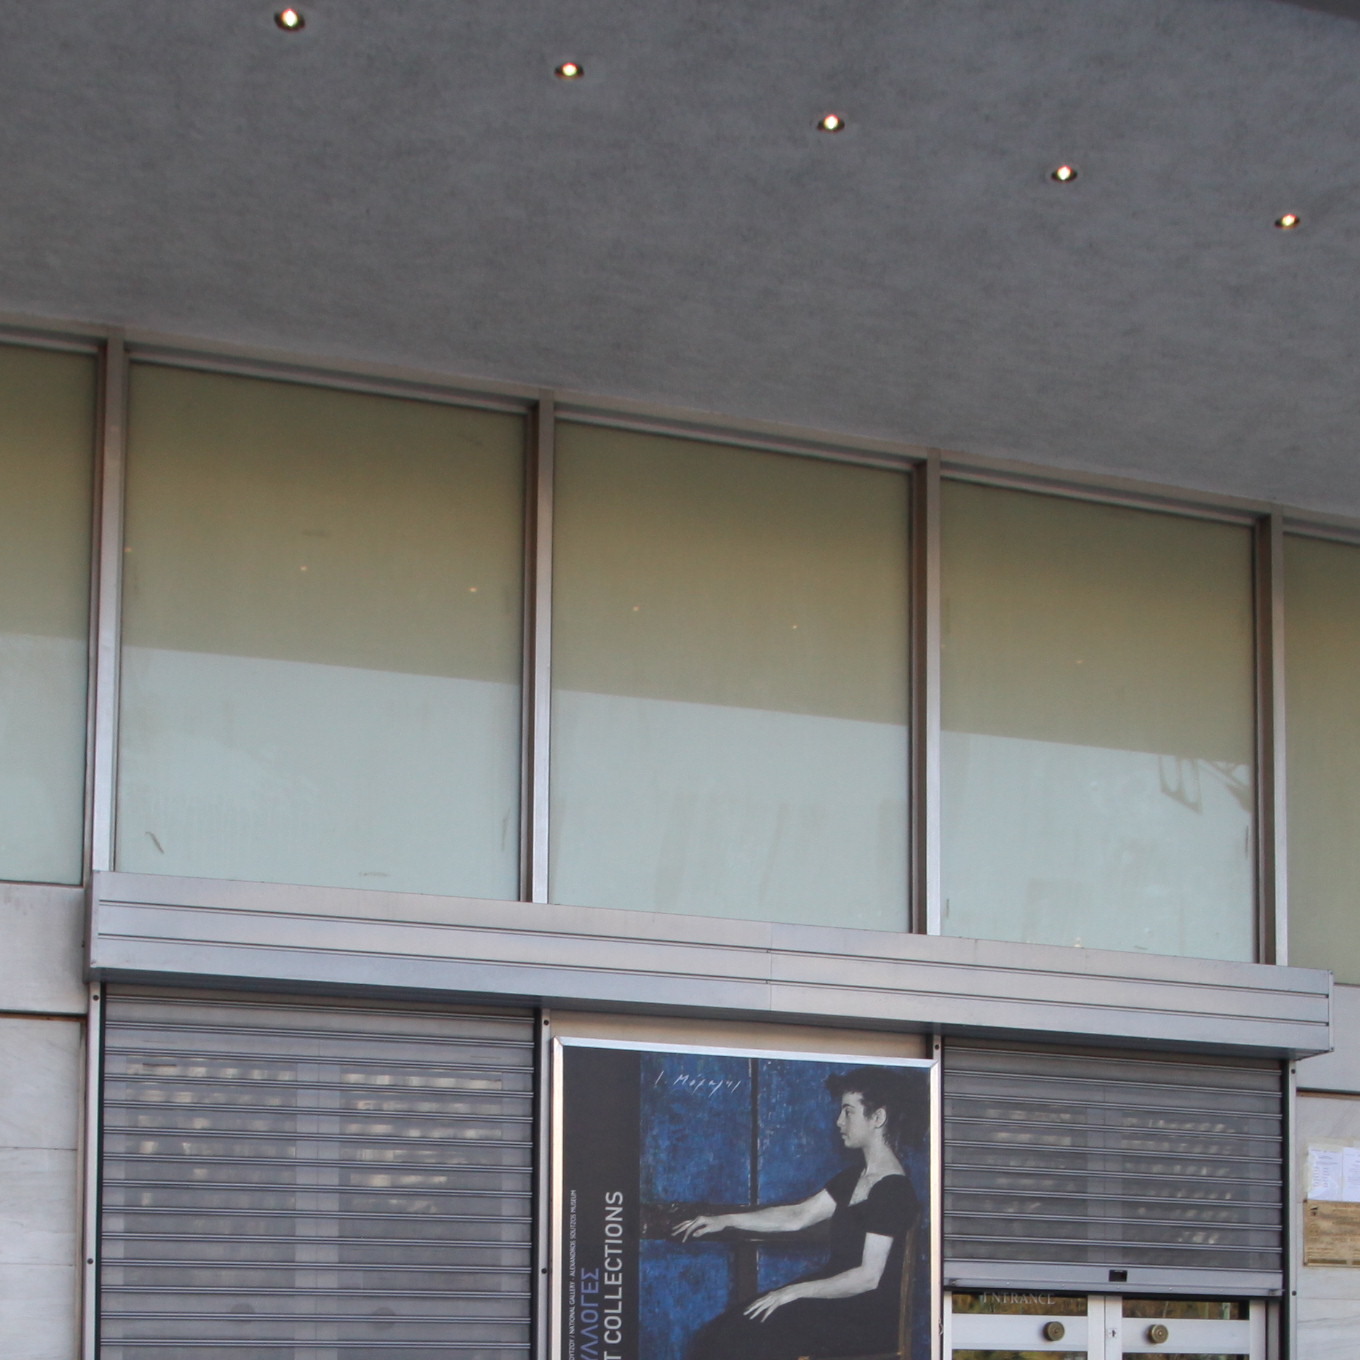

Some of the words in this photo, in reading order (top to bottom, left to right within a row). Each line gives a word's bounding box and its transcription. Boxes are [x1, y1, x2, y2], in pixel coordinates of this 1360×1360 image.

[569, 1240, 577, 1277] ALEXANDROS
[603, 1191, 623, 1345] COLLECTIONS
[983, 1291, 1056, 1305] ENTRANCE
[568, 1306, 576, 1334] NATIONAL
